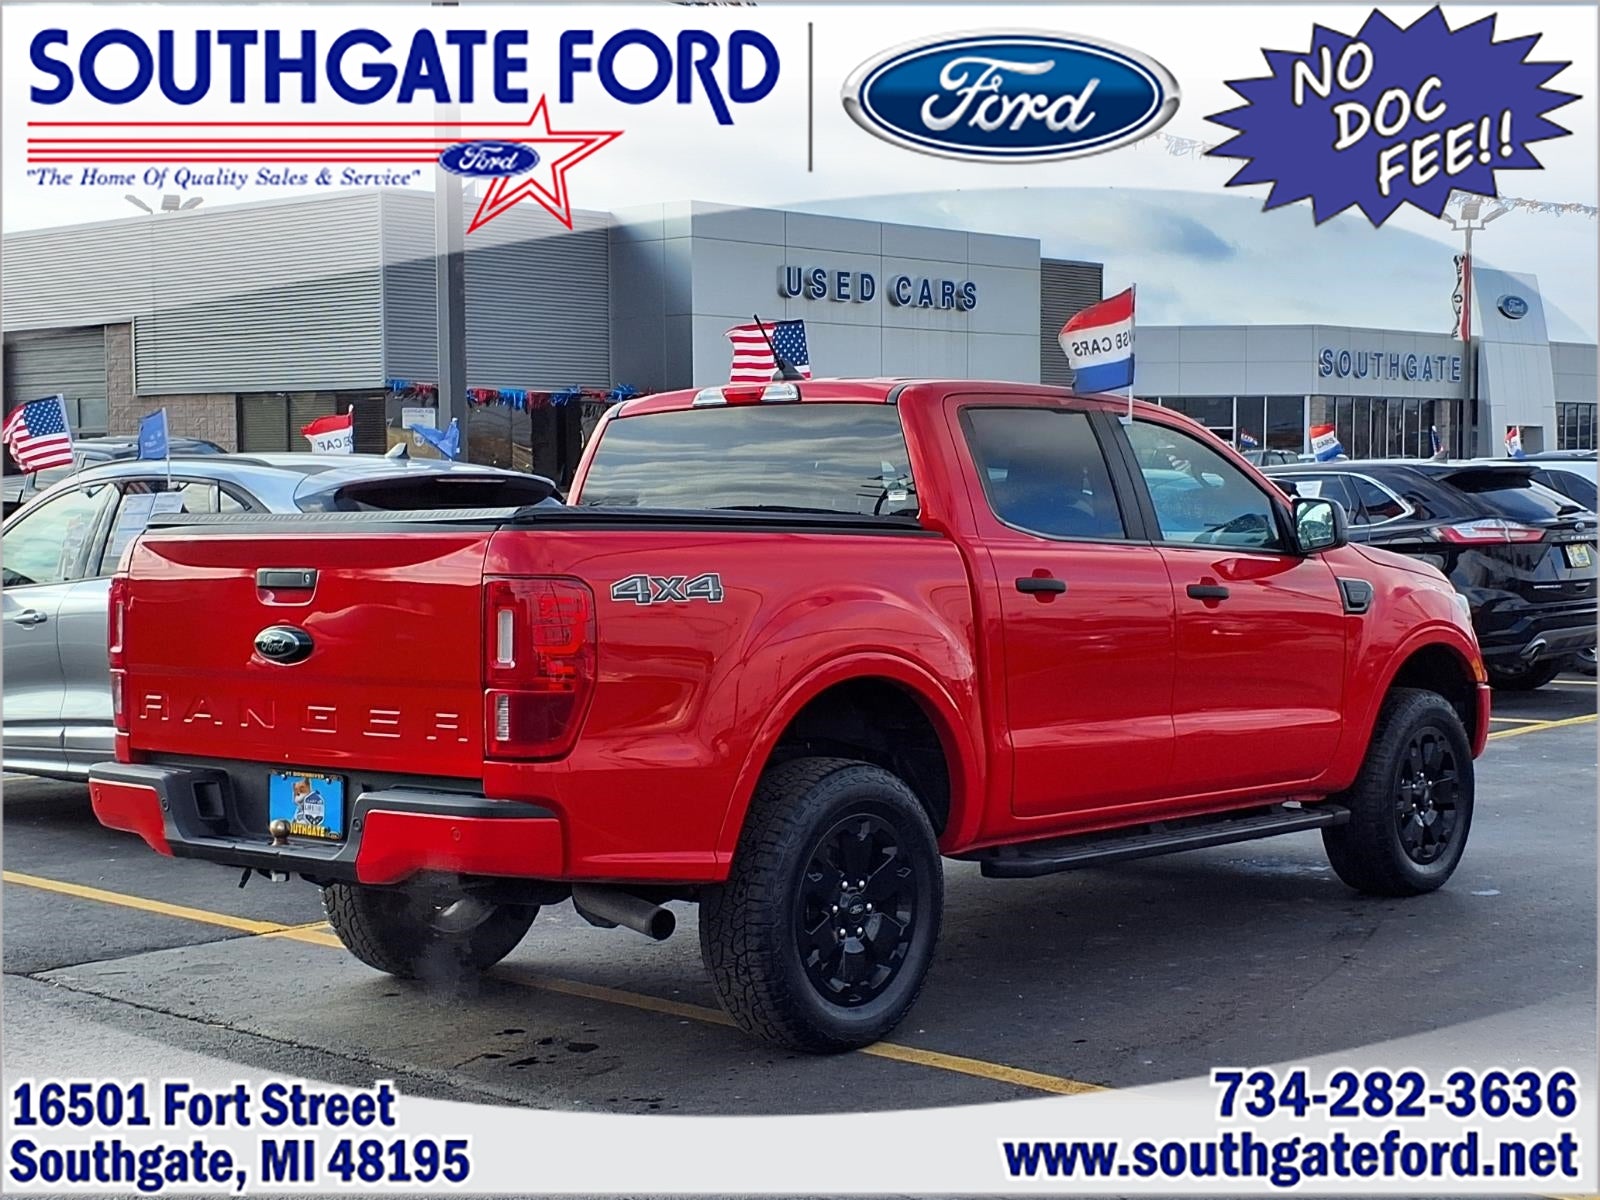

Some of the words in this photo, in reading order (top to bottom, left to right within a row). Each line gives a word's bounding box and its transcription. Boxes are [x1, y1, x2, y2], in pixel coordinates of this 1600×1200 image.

[779, 264, 876, 304] USED
[888, 274, 978, 312] CARS
[1320, 348, 1461, 382] SOUTHGATE
[138, 694, 470, 744] RANGER
